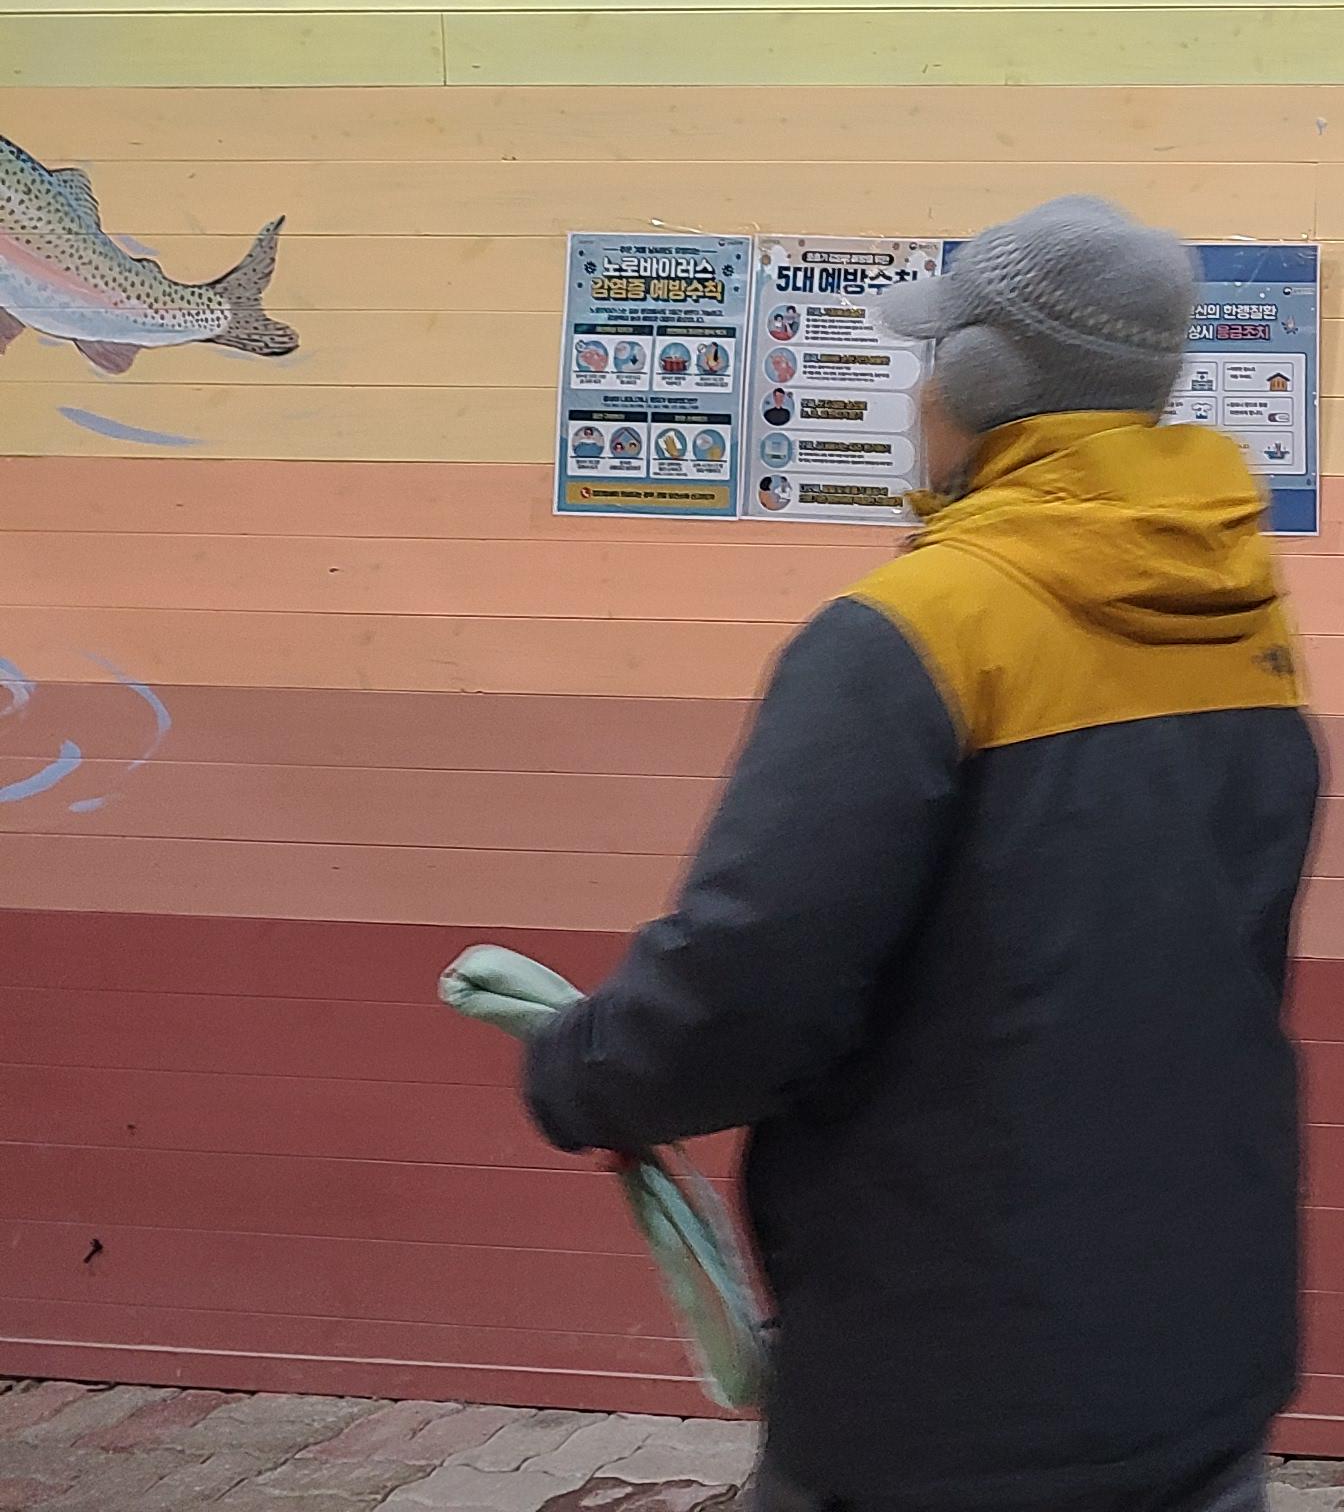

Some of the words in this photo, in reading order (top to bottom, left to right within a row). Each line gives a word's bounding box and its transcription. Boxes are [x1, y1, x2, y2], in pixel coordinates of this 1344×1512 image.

[602, 256, 717, 279] 노로바이러스
[775, 265, 815, 294] 5대
[591, 277, 648, 301] 감염증
[649, 279, 726, 304] 예방수칙
